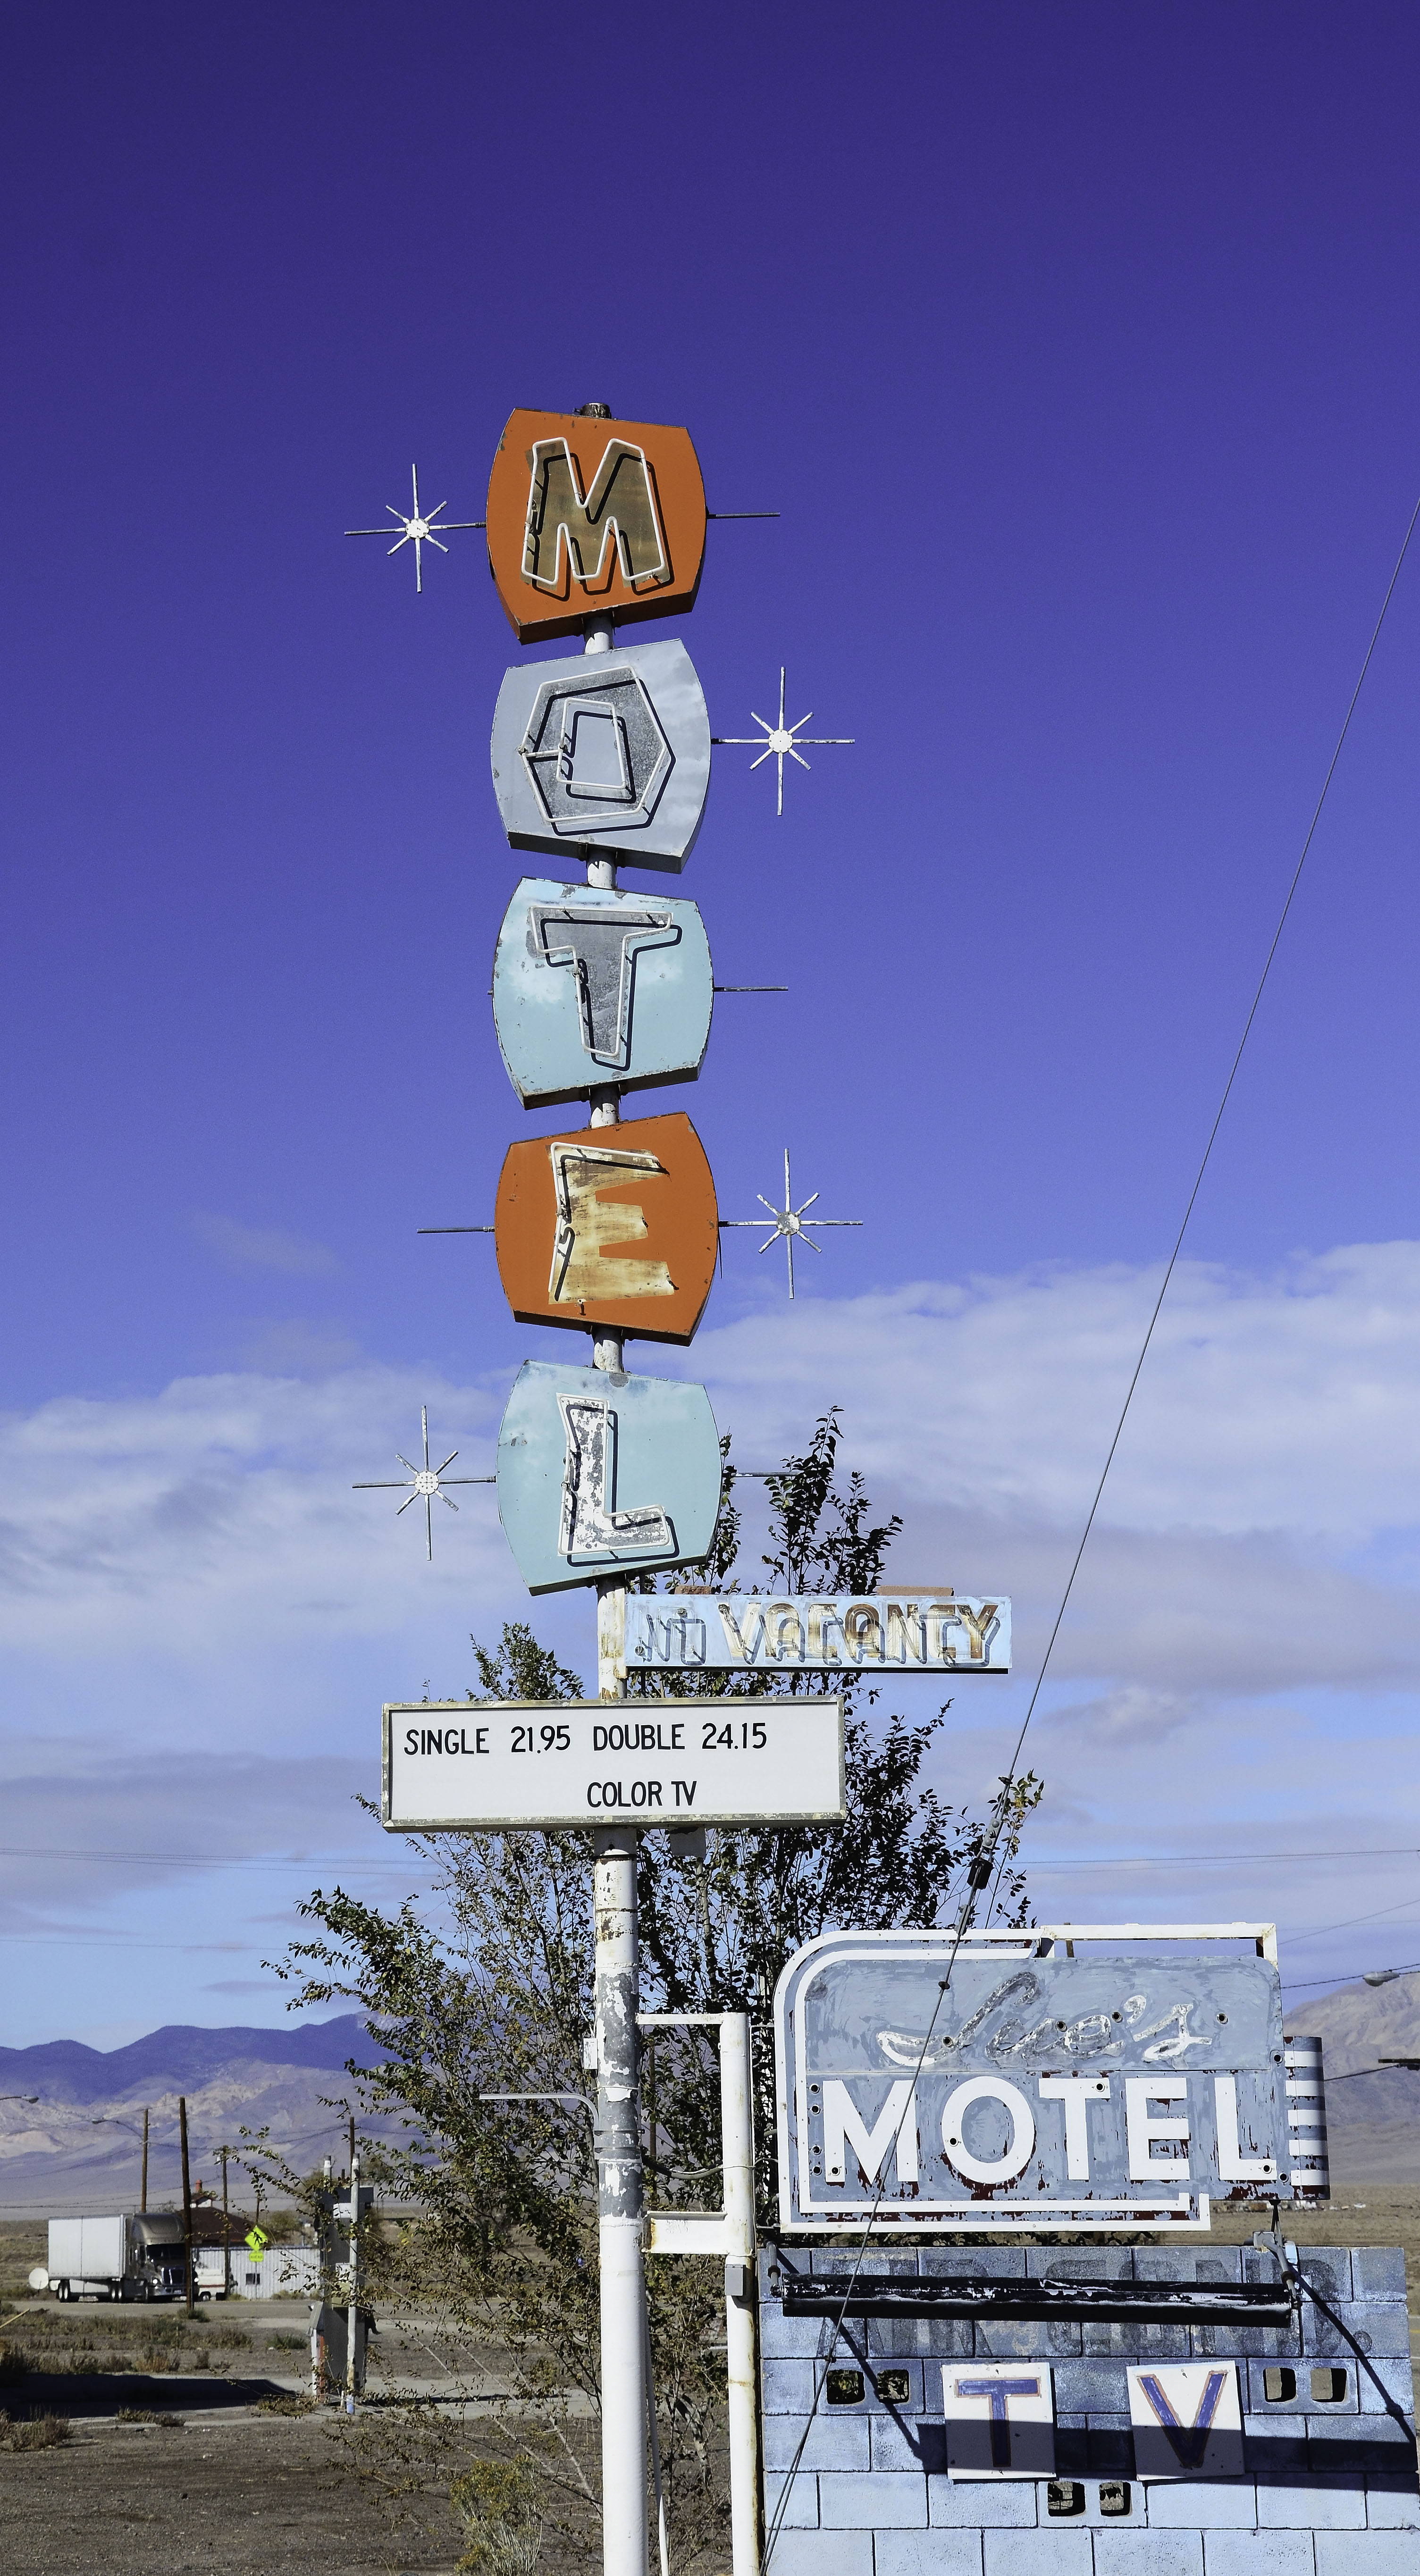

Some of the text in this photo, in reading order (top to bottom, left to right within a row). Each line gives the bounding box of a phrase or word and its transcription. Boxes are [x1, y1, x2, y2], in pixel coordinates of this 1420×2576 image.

[520, 436, 675, 1556] MOTEL
[717, 1602, 1000, 1666] VACANCY
[404, 1722, 767, 1755] SINGLE 21.95 DOUBLE 24.15
[587, 1780, 697, 1808] COLOR TV
[822, 2076, 1277, 2184] MOTEL
